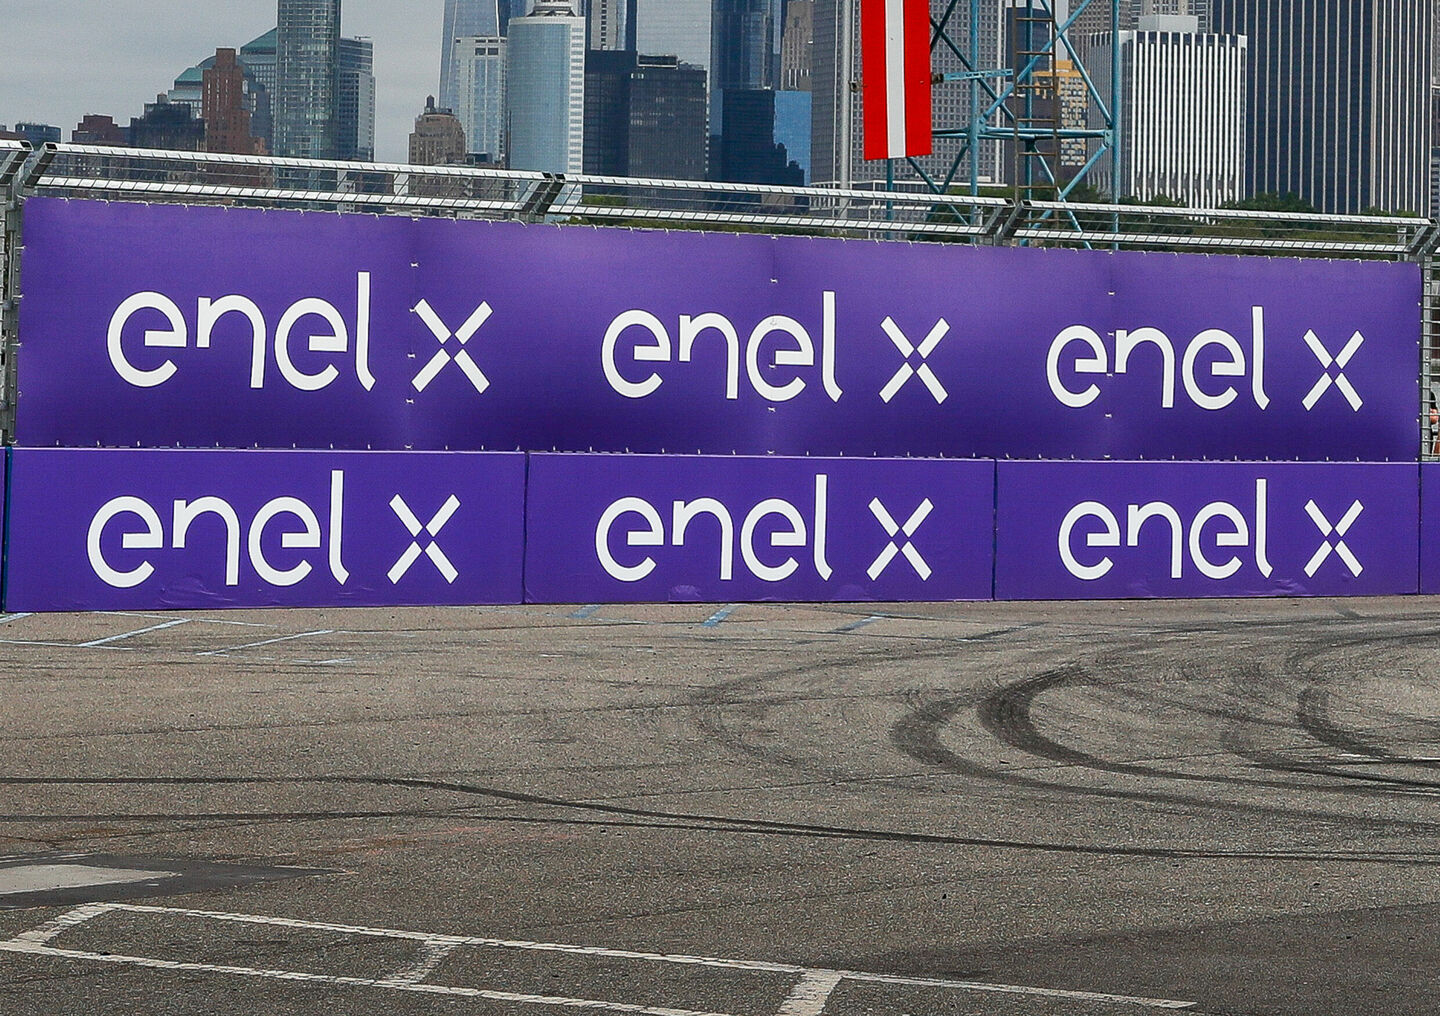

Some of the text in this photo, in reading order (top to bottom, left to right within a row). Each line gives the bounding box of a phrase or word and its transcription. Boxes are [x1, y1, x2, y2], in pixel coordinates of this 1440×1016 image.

[107, 271, 493, 394] enel x
[601, 290, 950, 405] enel x
[1046, 306, 1364, 412] enel x
[87, 469, 461, 588] enel x
[595, 474, 934, 583] enel x
[1058, 478, 1364, 580] enel x
